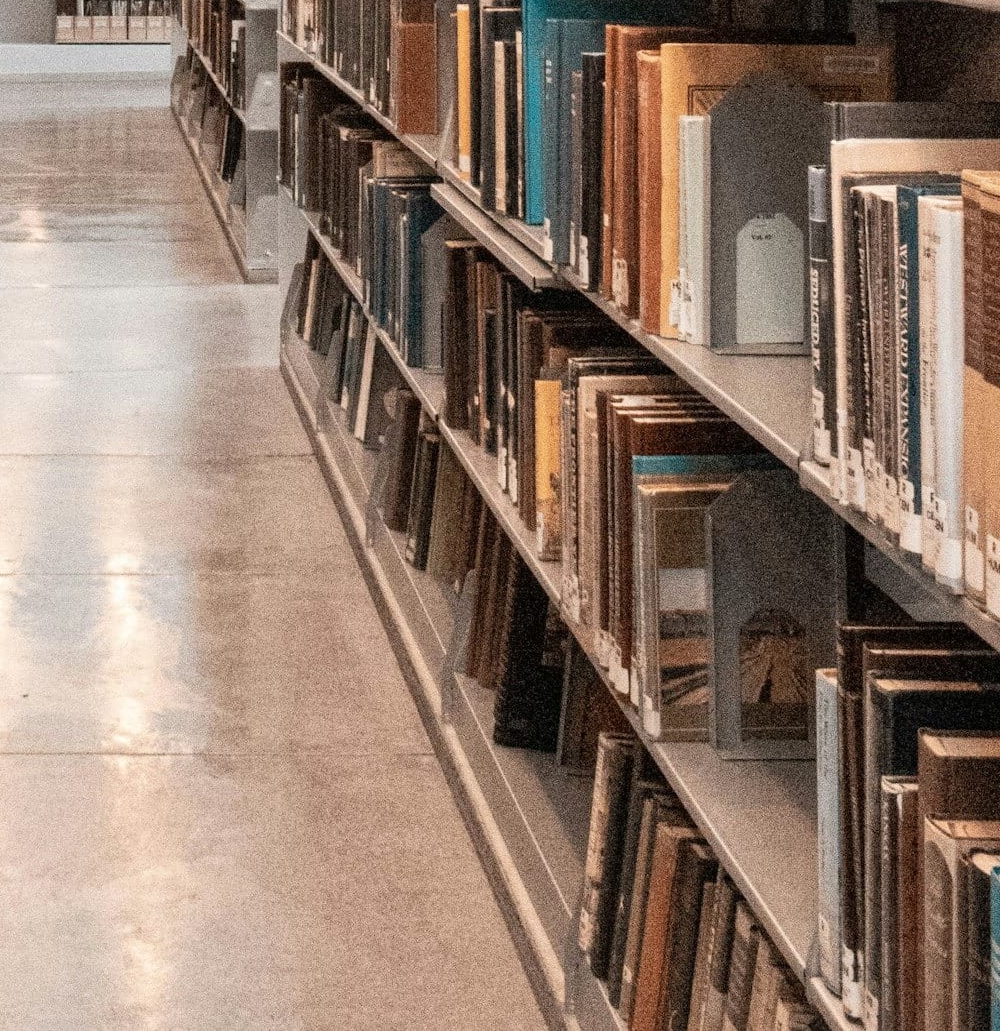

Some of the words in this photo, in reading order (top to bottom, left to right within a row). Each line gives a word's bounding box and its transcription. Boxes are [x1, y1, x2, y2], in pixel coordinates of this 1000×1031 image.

[811, 268, 820, 343] SEDUCED
[899, 243, 909, 372] WESTWARD
[812, 345, 820, 371] BY
[899, 373, 909, 481] EXPANSIO
